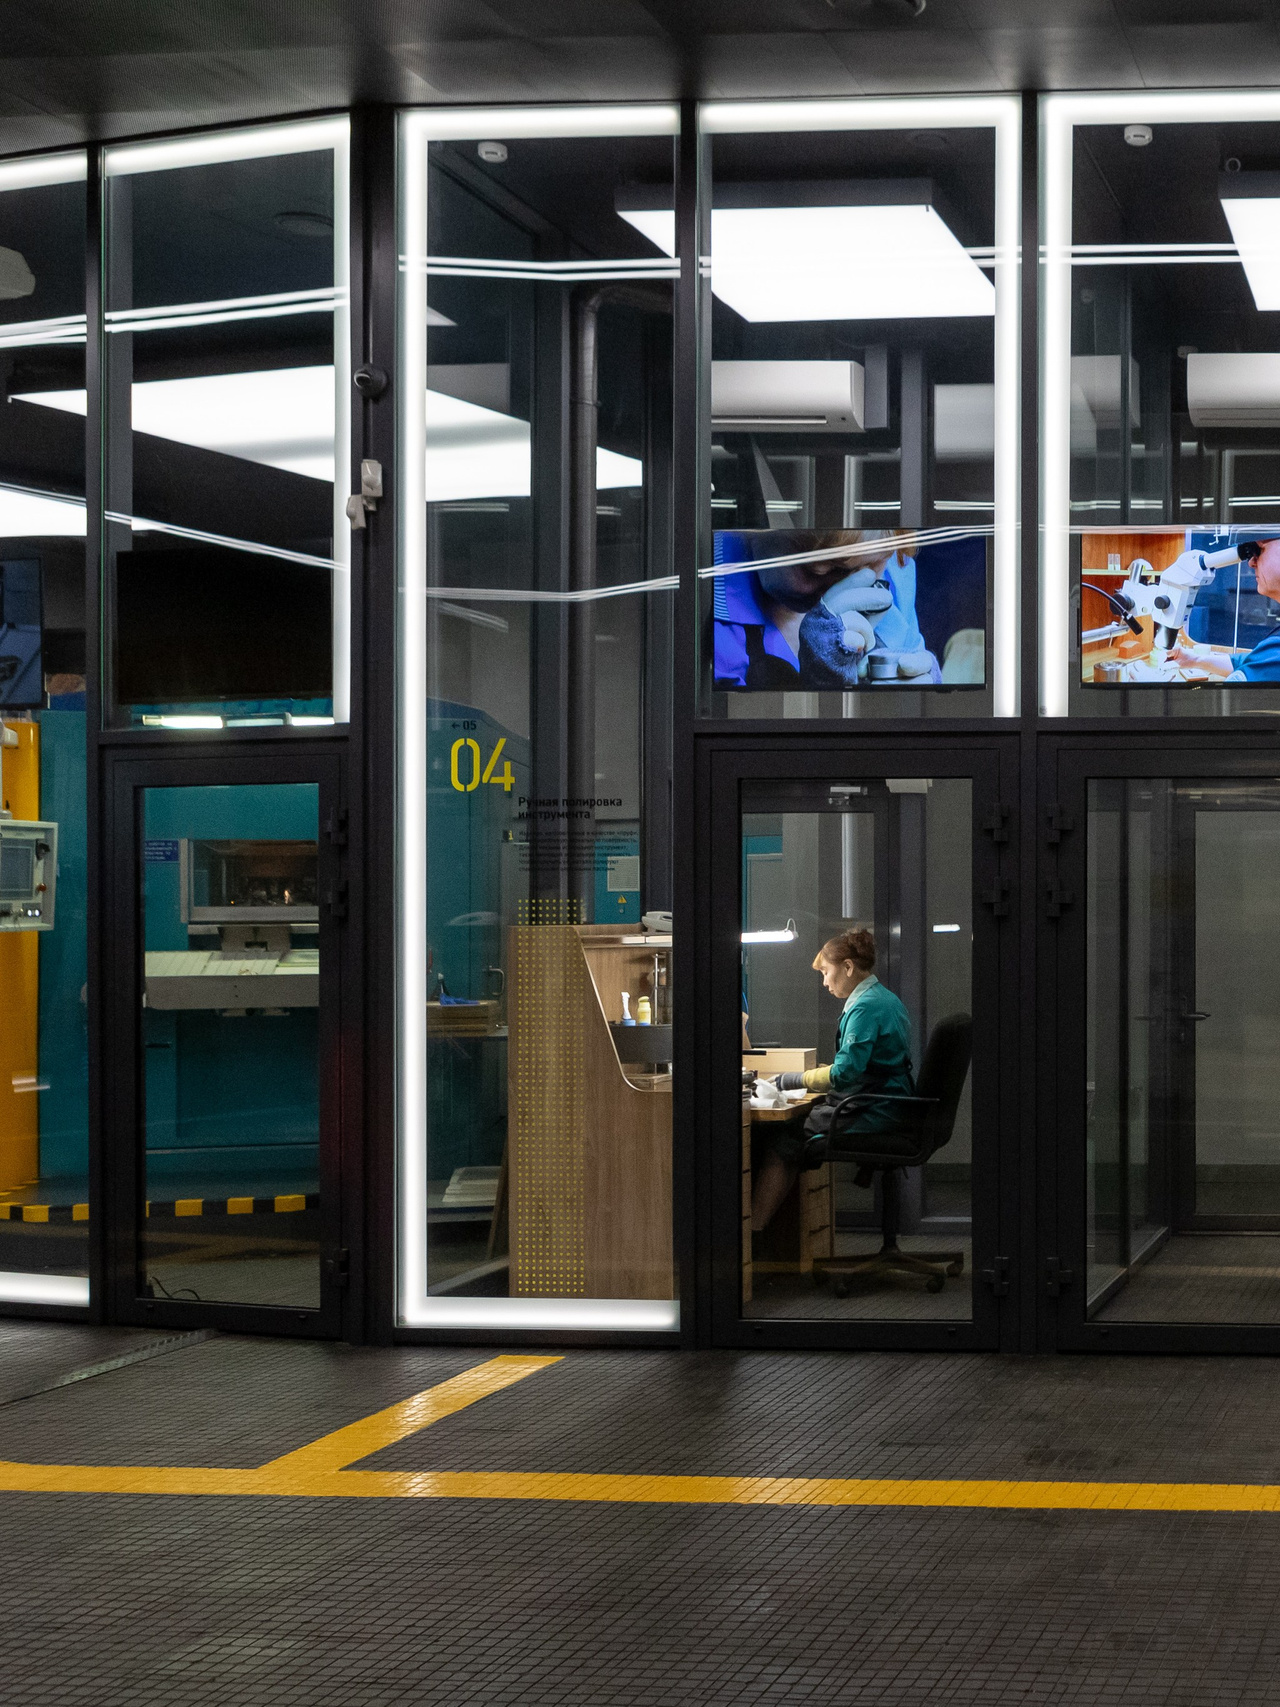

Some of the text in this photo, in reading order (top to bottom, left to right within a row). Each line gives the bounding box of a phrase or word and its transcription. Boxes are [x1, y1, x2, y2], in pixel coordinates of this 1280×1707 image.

[462, 720, 476, 730] 05
[450, 738, 516, 792] 04
[518, 797, 622, 810] Ручная полировка
[518, 811, 590, 821] инструмента
